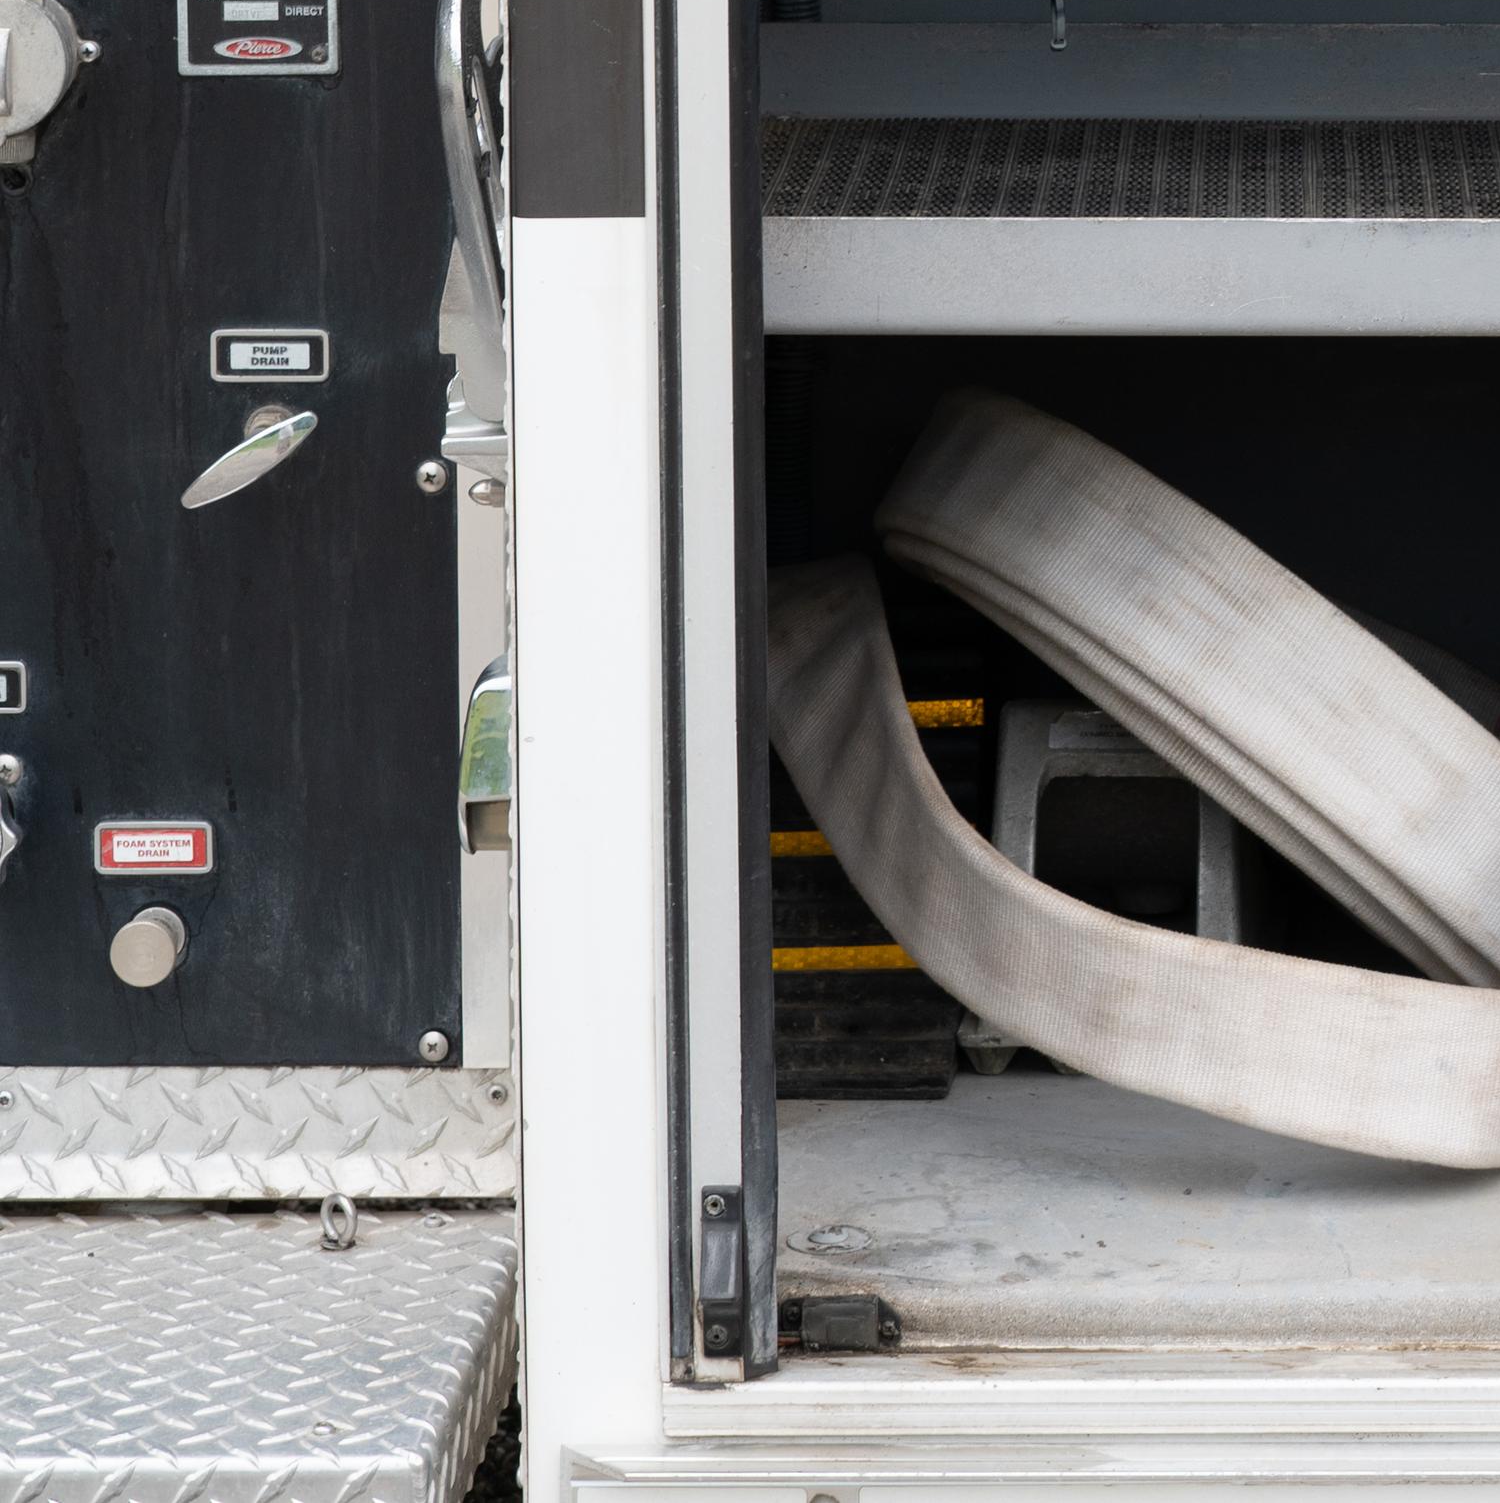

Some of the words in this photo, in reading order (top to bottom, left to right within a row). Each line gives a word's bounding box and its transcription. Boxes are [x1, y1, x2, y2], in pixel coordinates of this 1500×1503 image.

[285, 6, 324, 16] DIRECT
[234, 41, 283, 57] Pierce
[252, 346, 288, 355] PUMP
[250, 357, 290, 366] DRAIN
[116, 840, 146, 849] FOAM
[149, 839, 191, 848] SYSTEM
[137, 849, 170, 858] DRAIN
